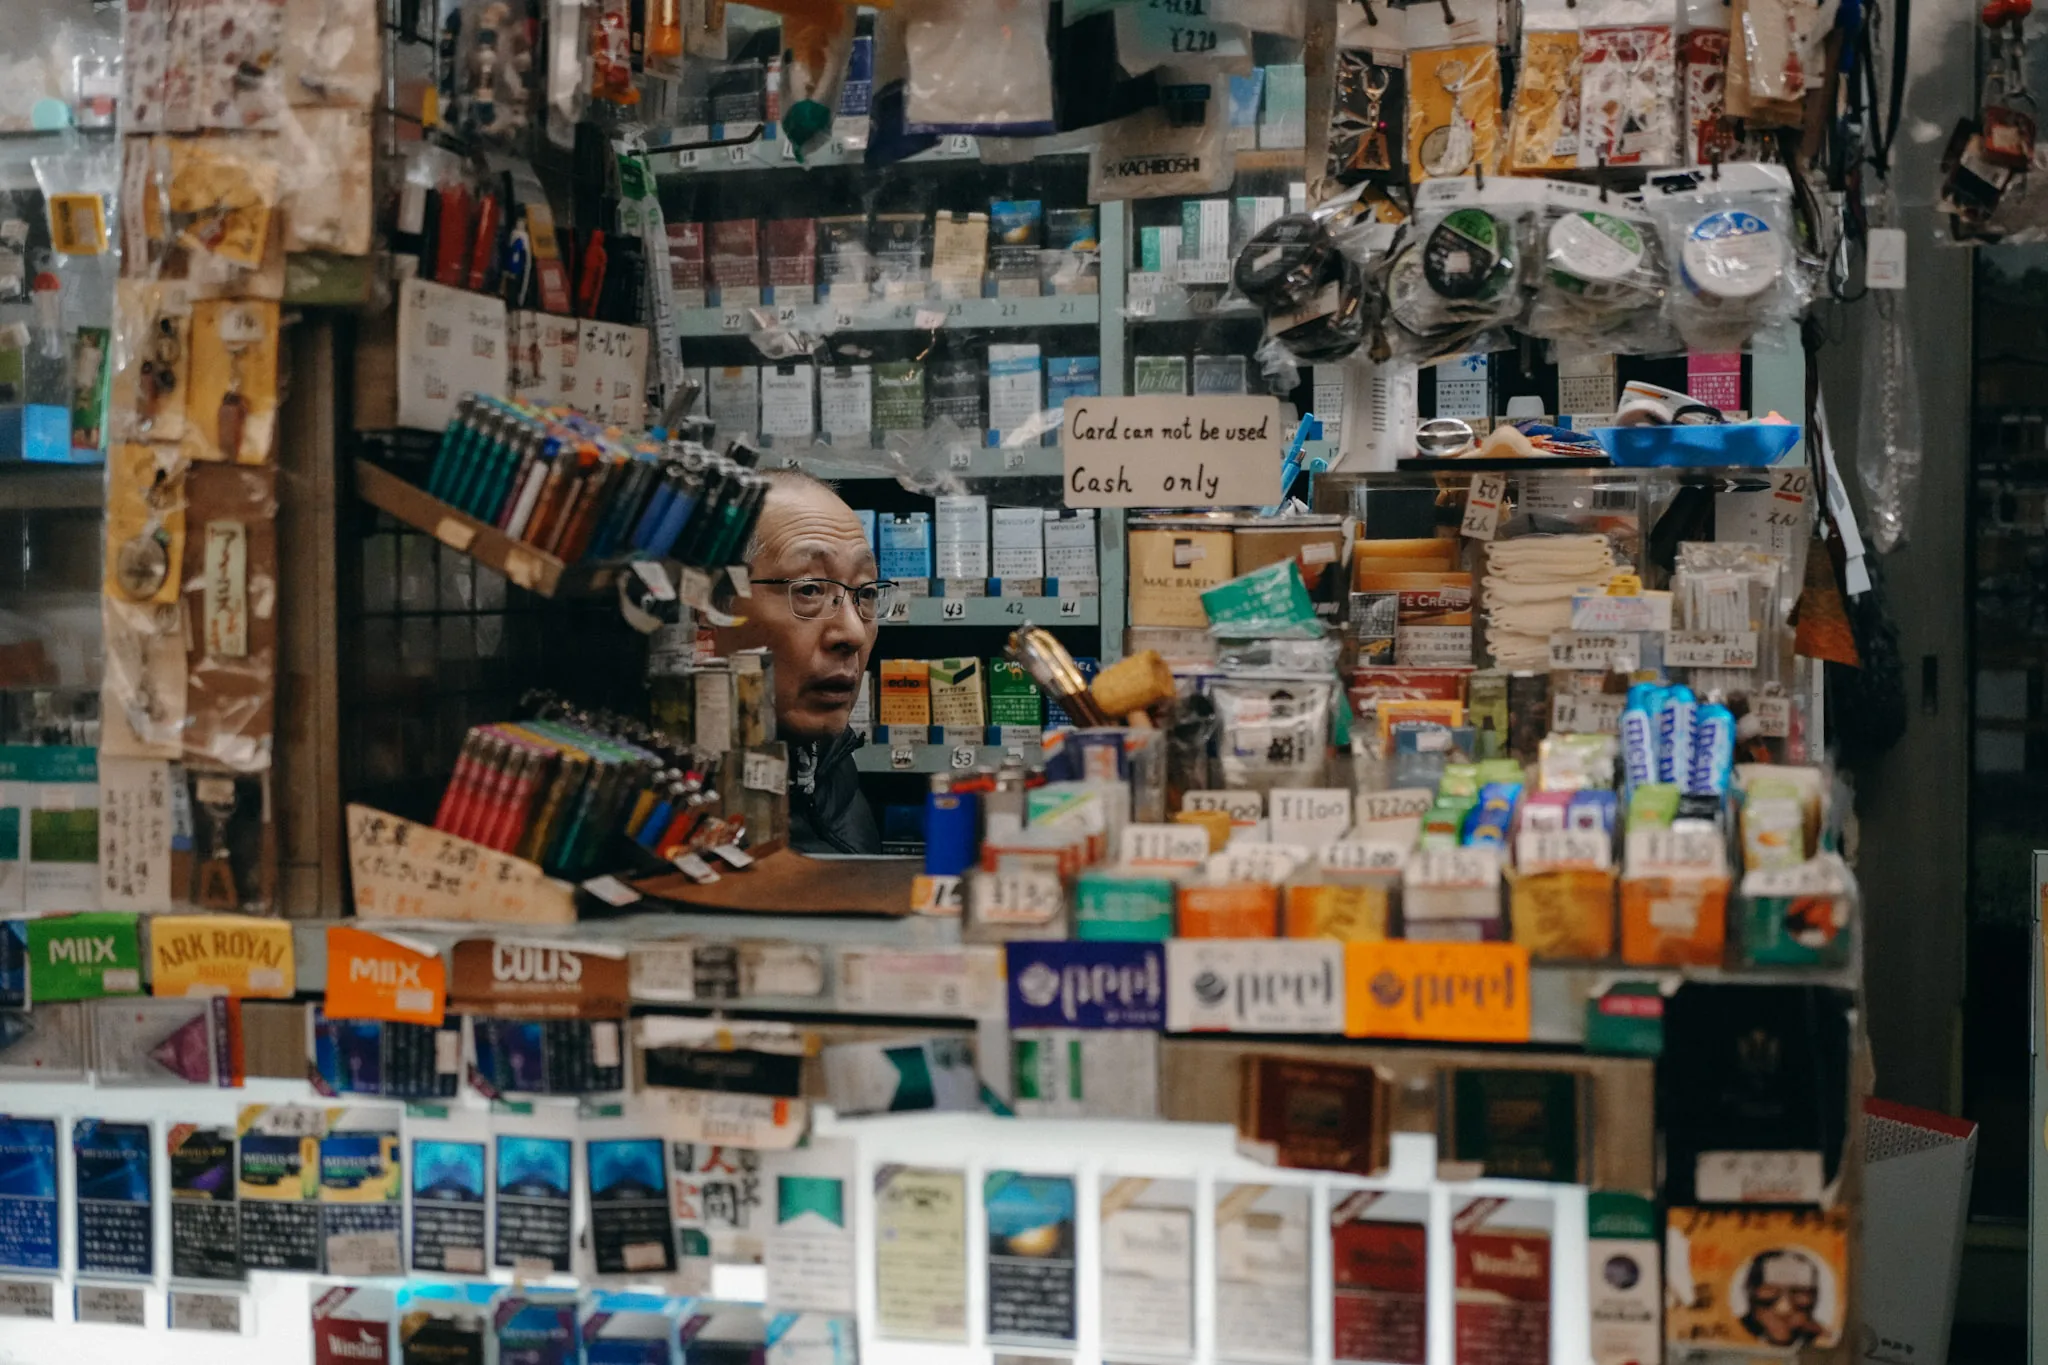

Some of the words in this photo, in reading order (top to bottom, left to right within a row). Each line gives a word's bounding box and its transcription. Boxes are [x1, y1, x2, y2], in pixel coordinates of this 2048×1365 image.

[1118, 158, 1200, 177] KACHIBOSHI
[1072, 408, 1118, 440] Card
[1123, 426, 1154, 440] can
[1162, 417, 1192, 440] not
[1200, 419, 1220, 440] be
[1225, 415, 1269, 441] used
[1071, 465, 1133, 493] Cash
[1163, 464, 1219, 499] only
[1478, 480, 1498, 500] 50
[1778, 472, 1807, 493] 20
[945, 603, 963, 617] 43
[1005, 602, 1024, 615] 42
[1061, 602, 1076, 613] 41
[888, 677, 920, 689] echo
[955, 752, 973, 766] 53
[157, 933, 209, 969] ARK
[212, 930, 286, 969] ROYAL
